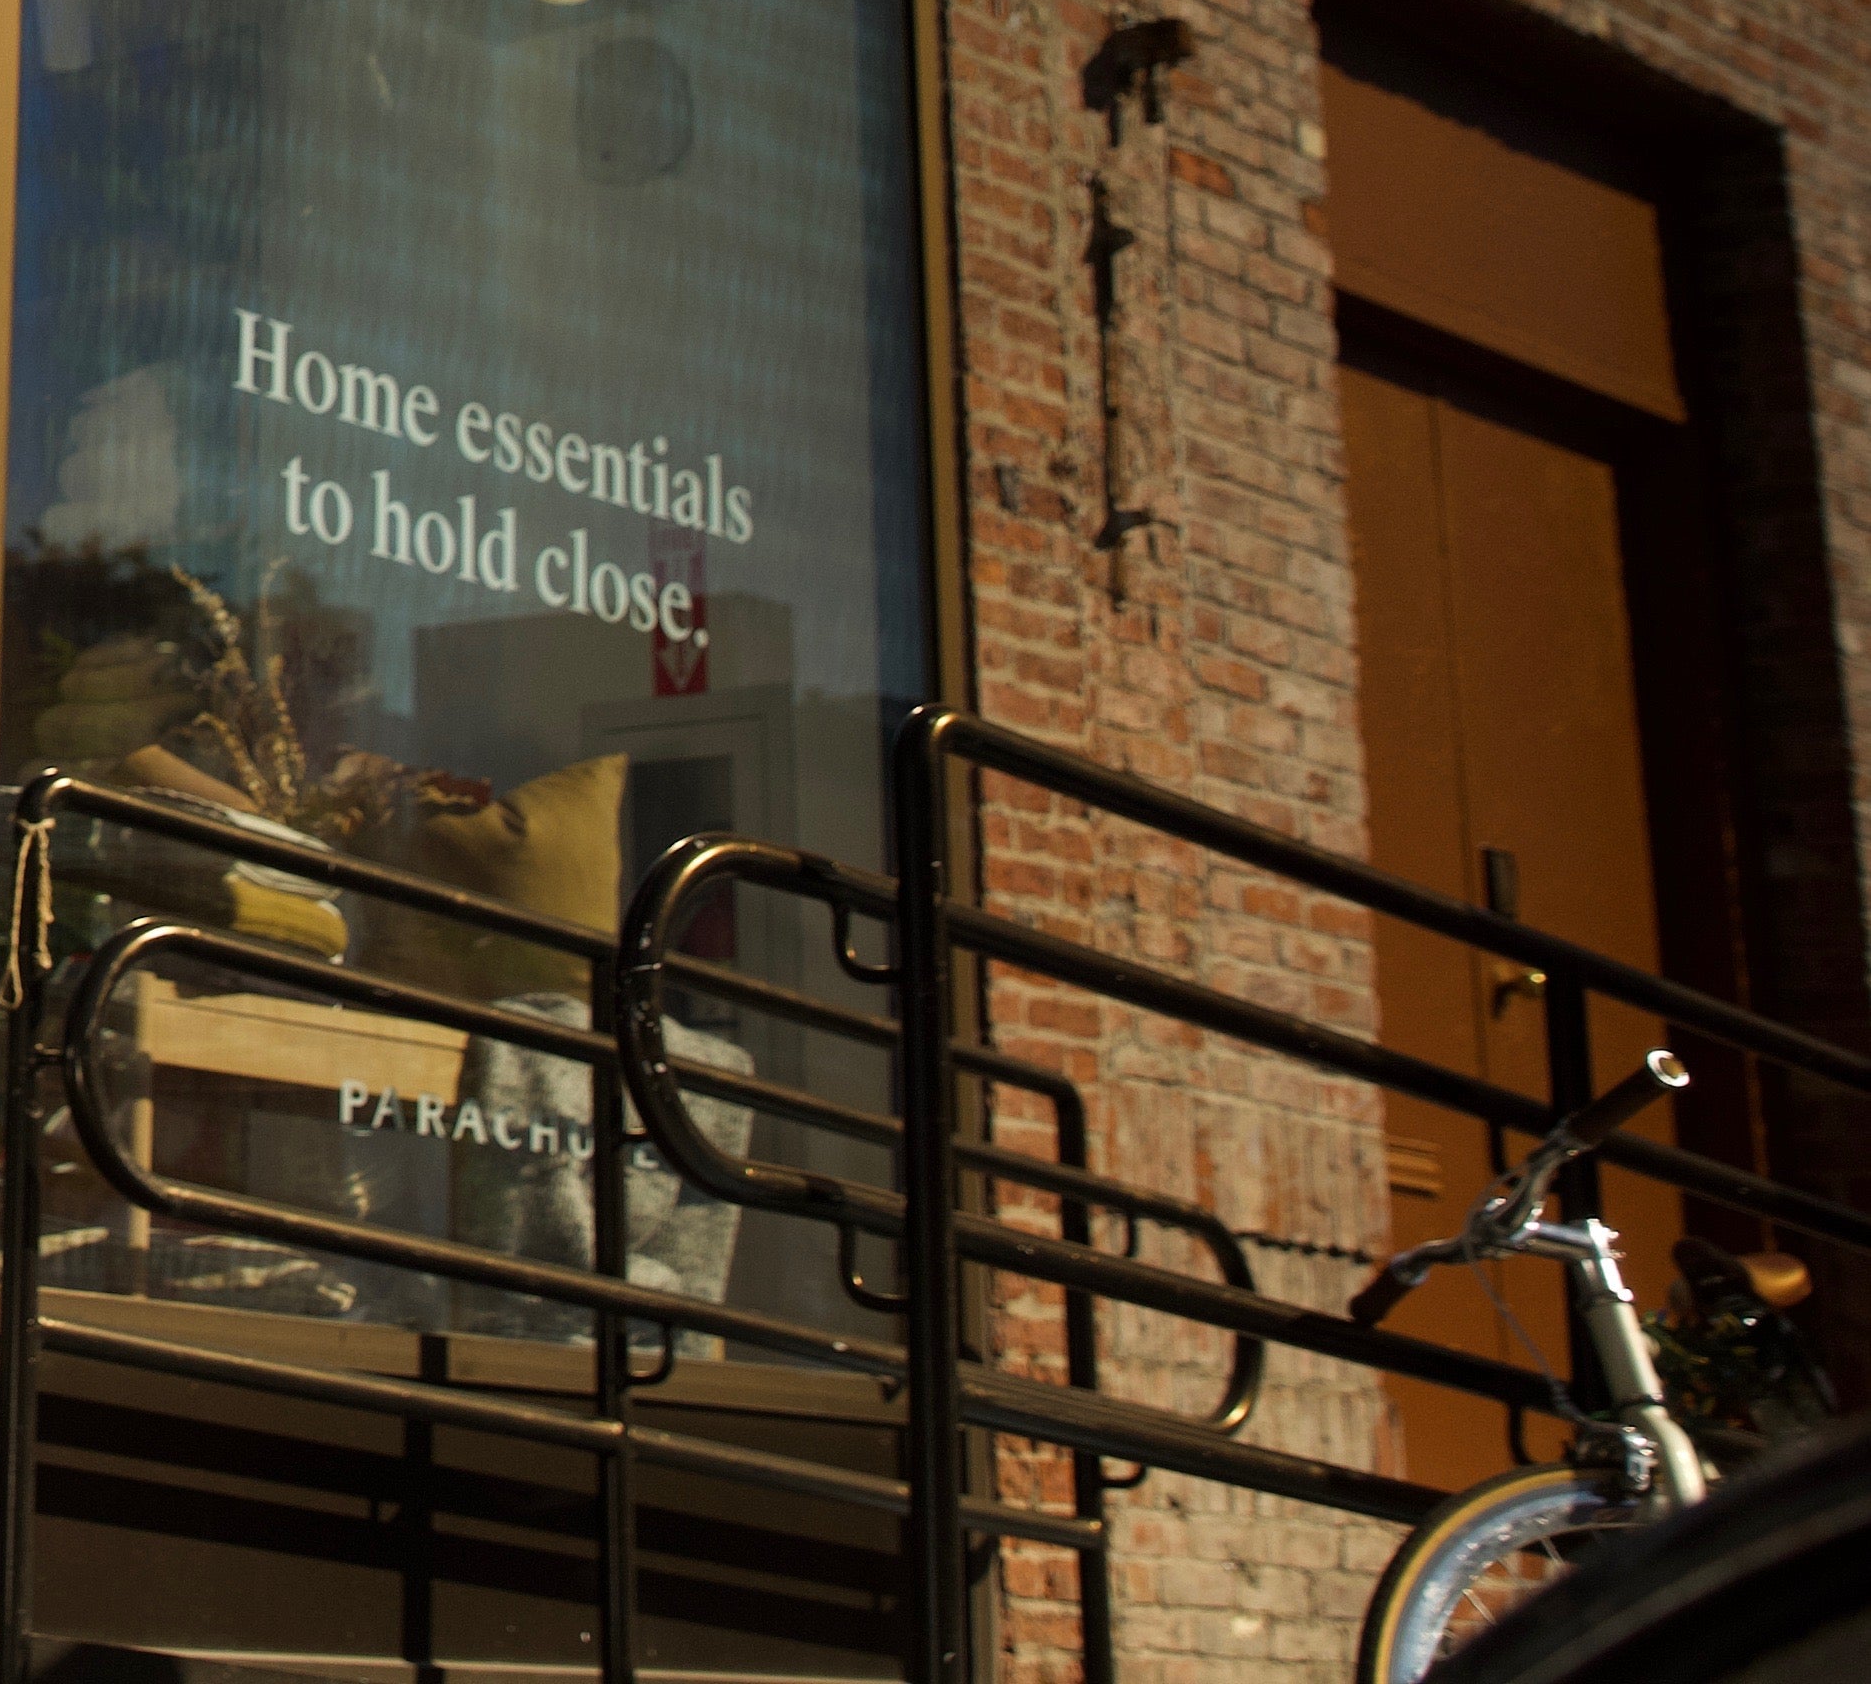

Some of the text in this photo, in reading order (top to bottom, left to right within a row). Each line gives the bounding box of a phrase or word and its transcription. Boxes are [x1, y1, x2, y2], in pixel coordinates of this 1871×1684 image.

[232, 306, 754, 544] Home essentials
[281, 454, 710, 649] to hold close.
